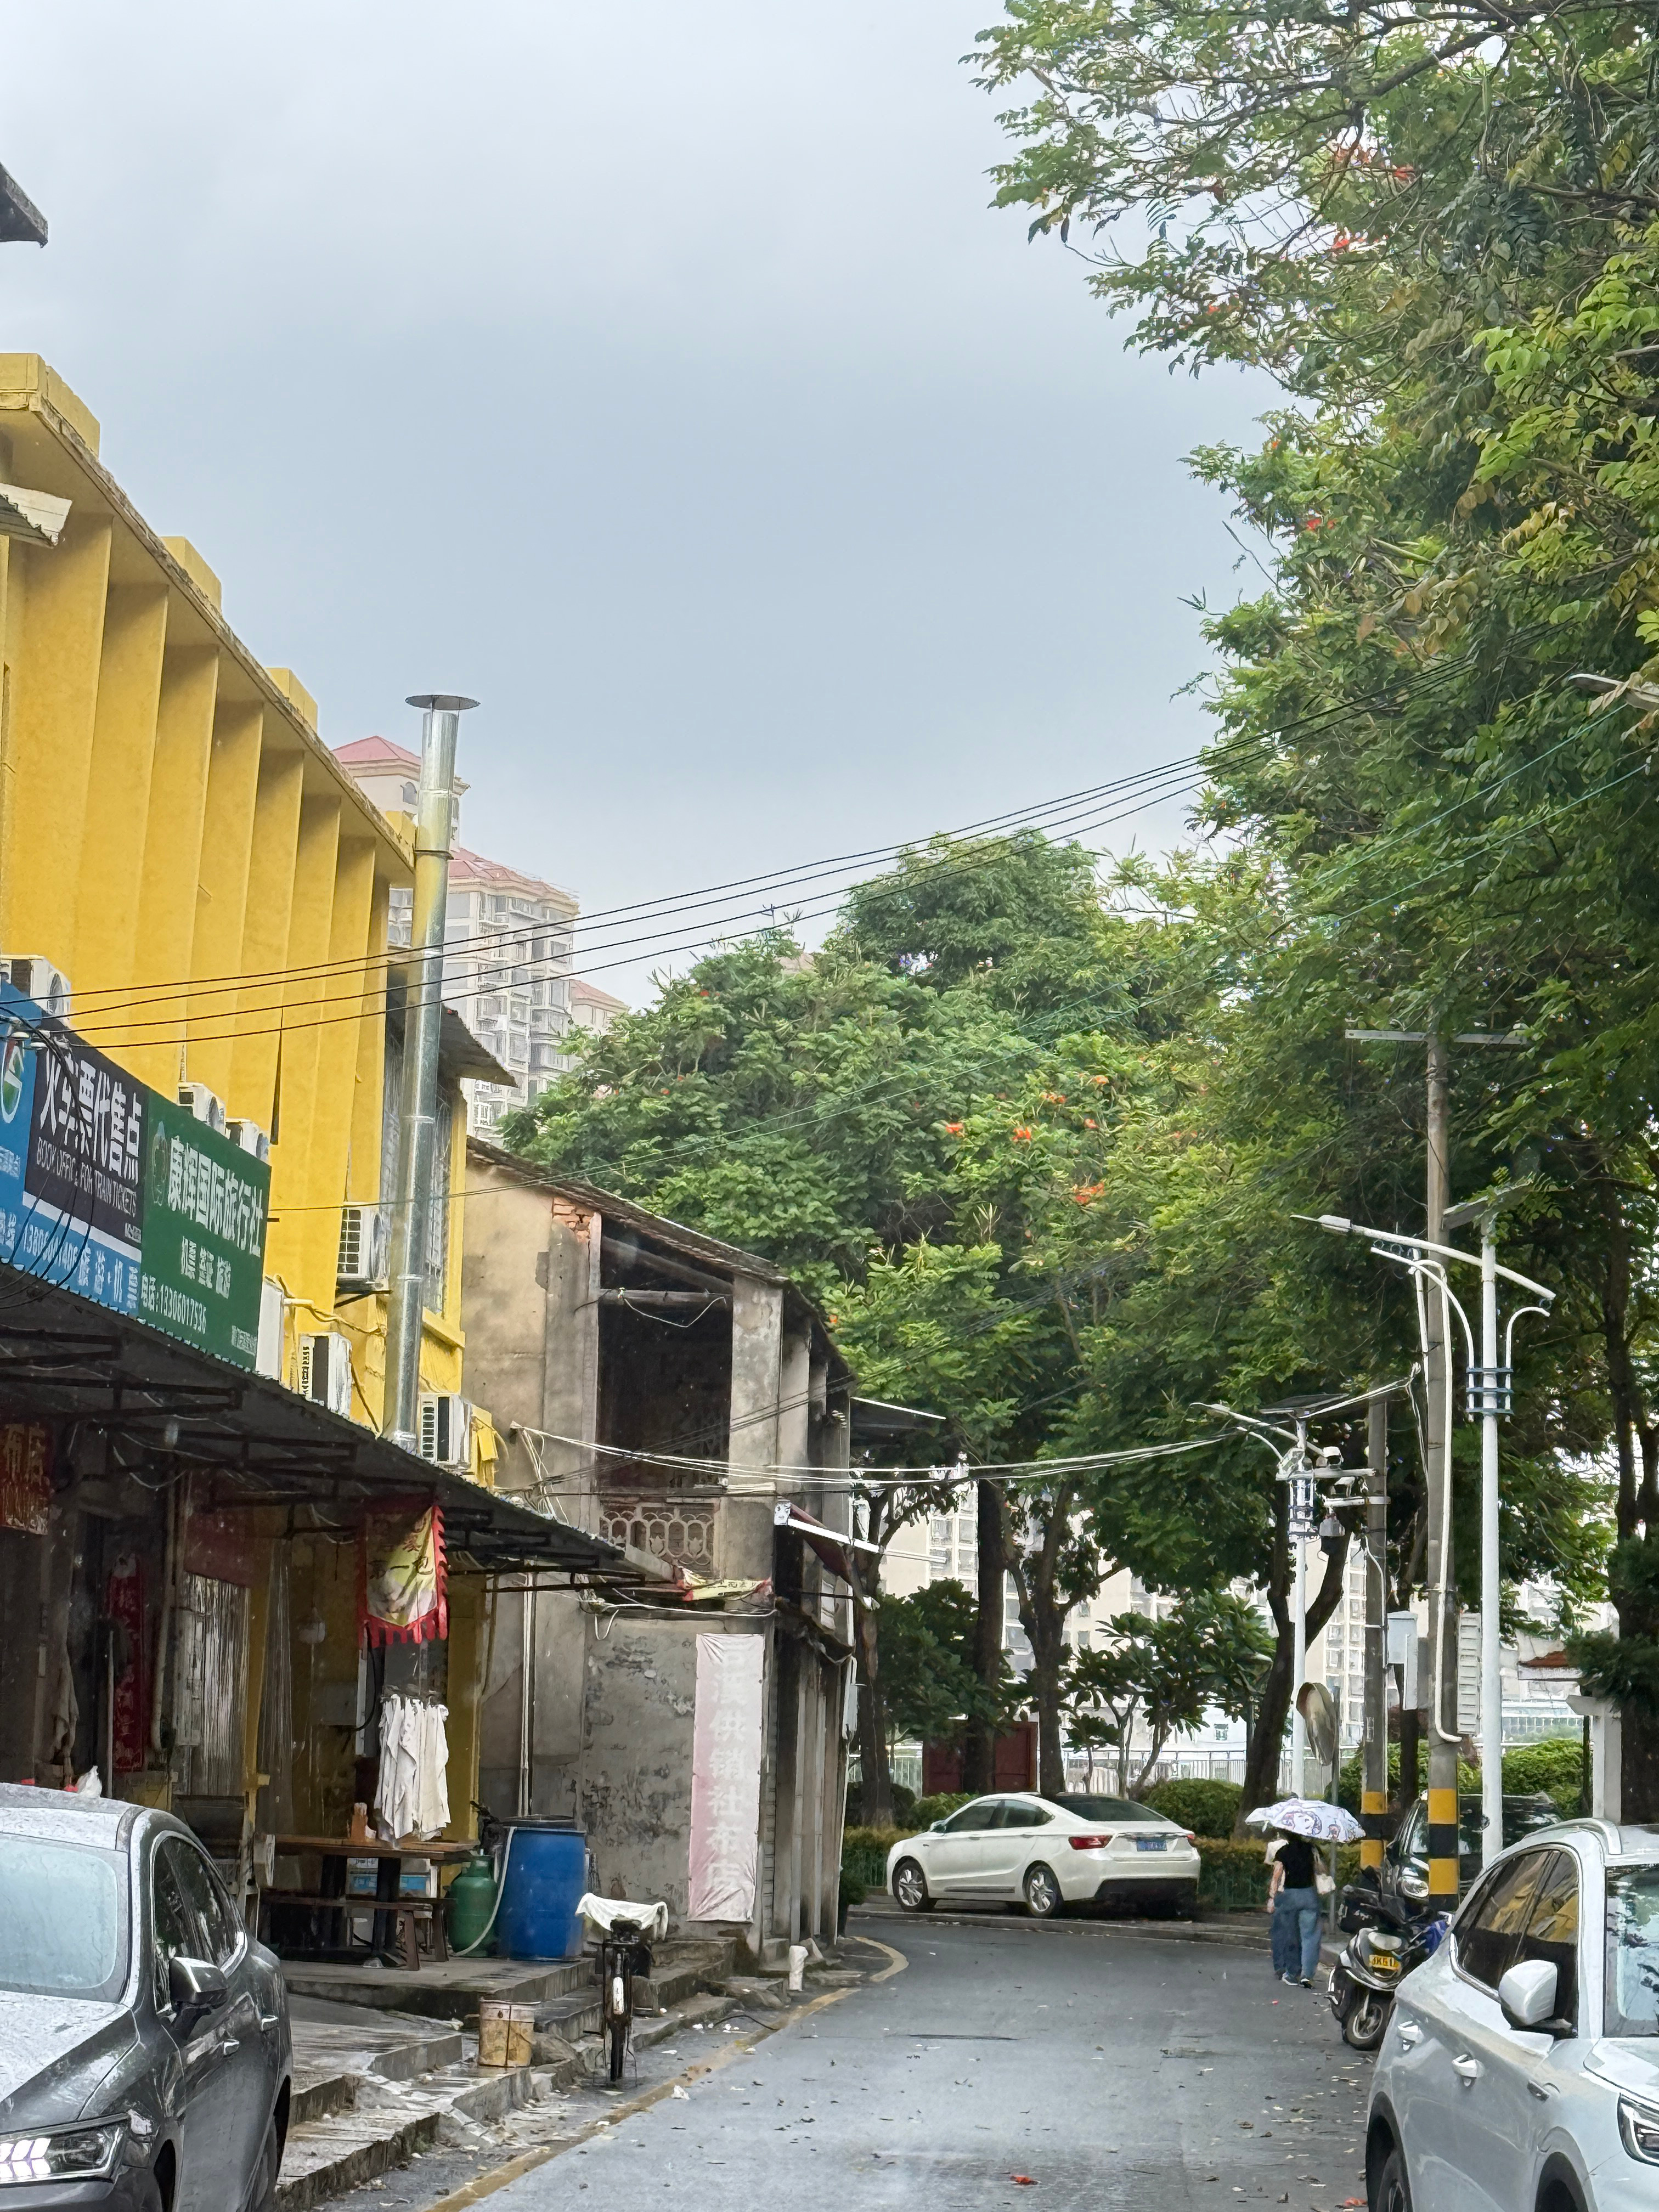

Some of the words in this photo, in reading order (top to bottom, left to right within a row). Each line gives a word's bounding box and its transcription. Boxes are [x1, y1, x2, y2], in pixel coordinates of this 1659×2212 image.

[40, 1048, 142, 1185] 火车票代售点
[168, 1135, 263, 1257] 康辉国际旅行社
